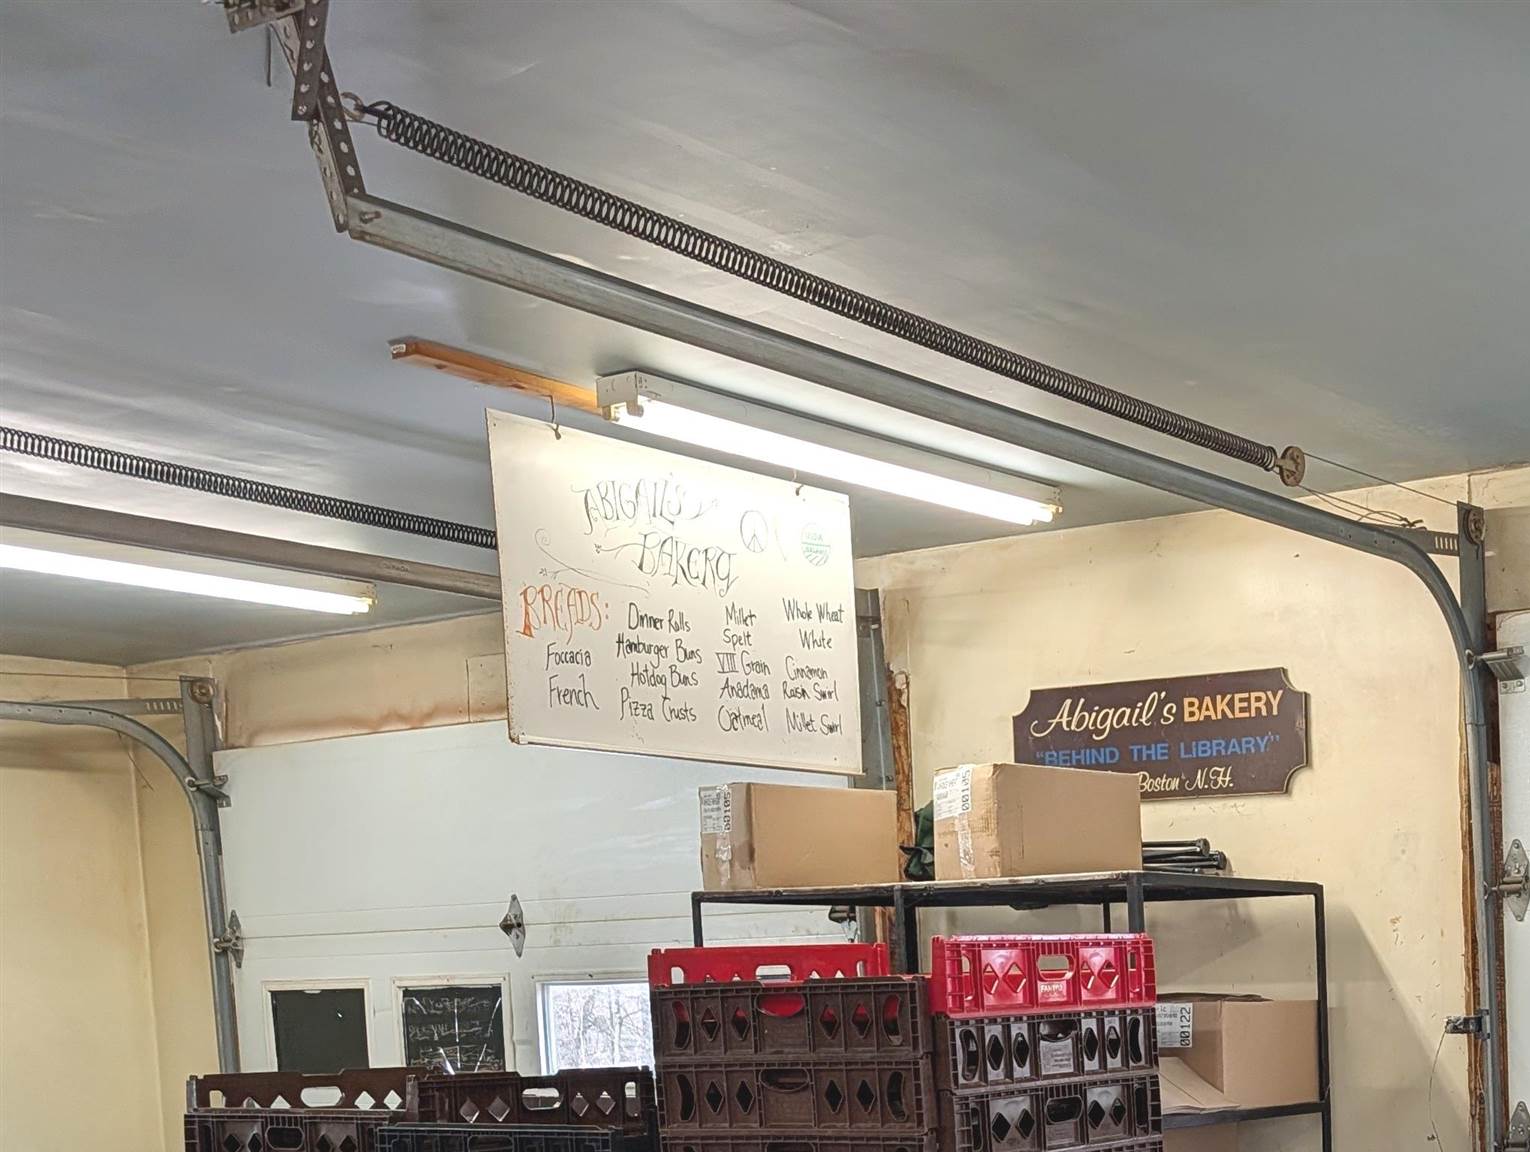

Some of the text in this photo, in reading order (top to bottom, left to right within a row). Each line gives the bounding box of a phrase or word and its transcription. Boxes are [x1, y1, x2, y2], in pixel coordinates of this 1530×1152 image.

[628, 602, 692, 634] Dinner Rolls
[724, 601, 757, 627] Millet
[782, 597, 845, 624] Whole Wheat
[615, 632, 703, 669] Hamburger Buns
[722, 628, 753, 651] Spelt
[798, 628, 833, 650] White
[545, 641, 592, 671] Foccacia
[715, 650, 772, 676] VIII Grain
[785, 655, 830, 681] Cinnamon
[548, 673, 600, 710] French
[630, 661, 699, 697] Hotdog Buns
[719, 677, 771, 700] Anadama
[782, 679, 839, 702] Raisin Swirl
[619, 686, 698, 723] Pizza Crusts
[717, 703, 769, 732] Oatmeal
[1030, 689, 1284, 741] Abigail's BAKERY
[785, 706, 843, 736] Millet Swirl
[1129, 742, 1169, 761] THE
[1138, 765, 1234, 793] Boston N.H.
[1179, 1006, 1191, 1047] 00122
